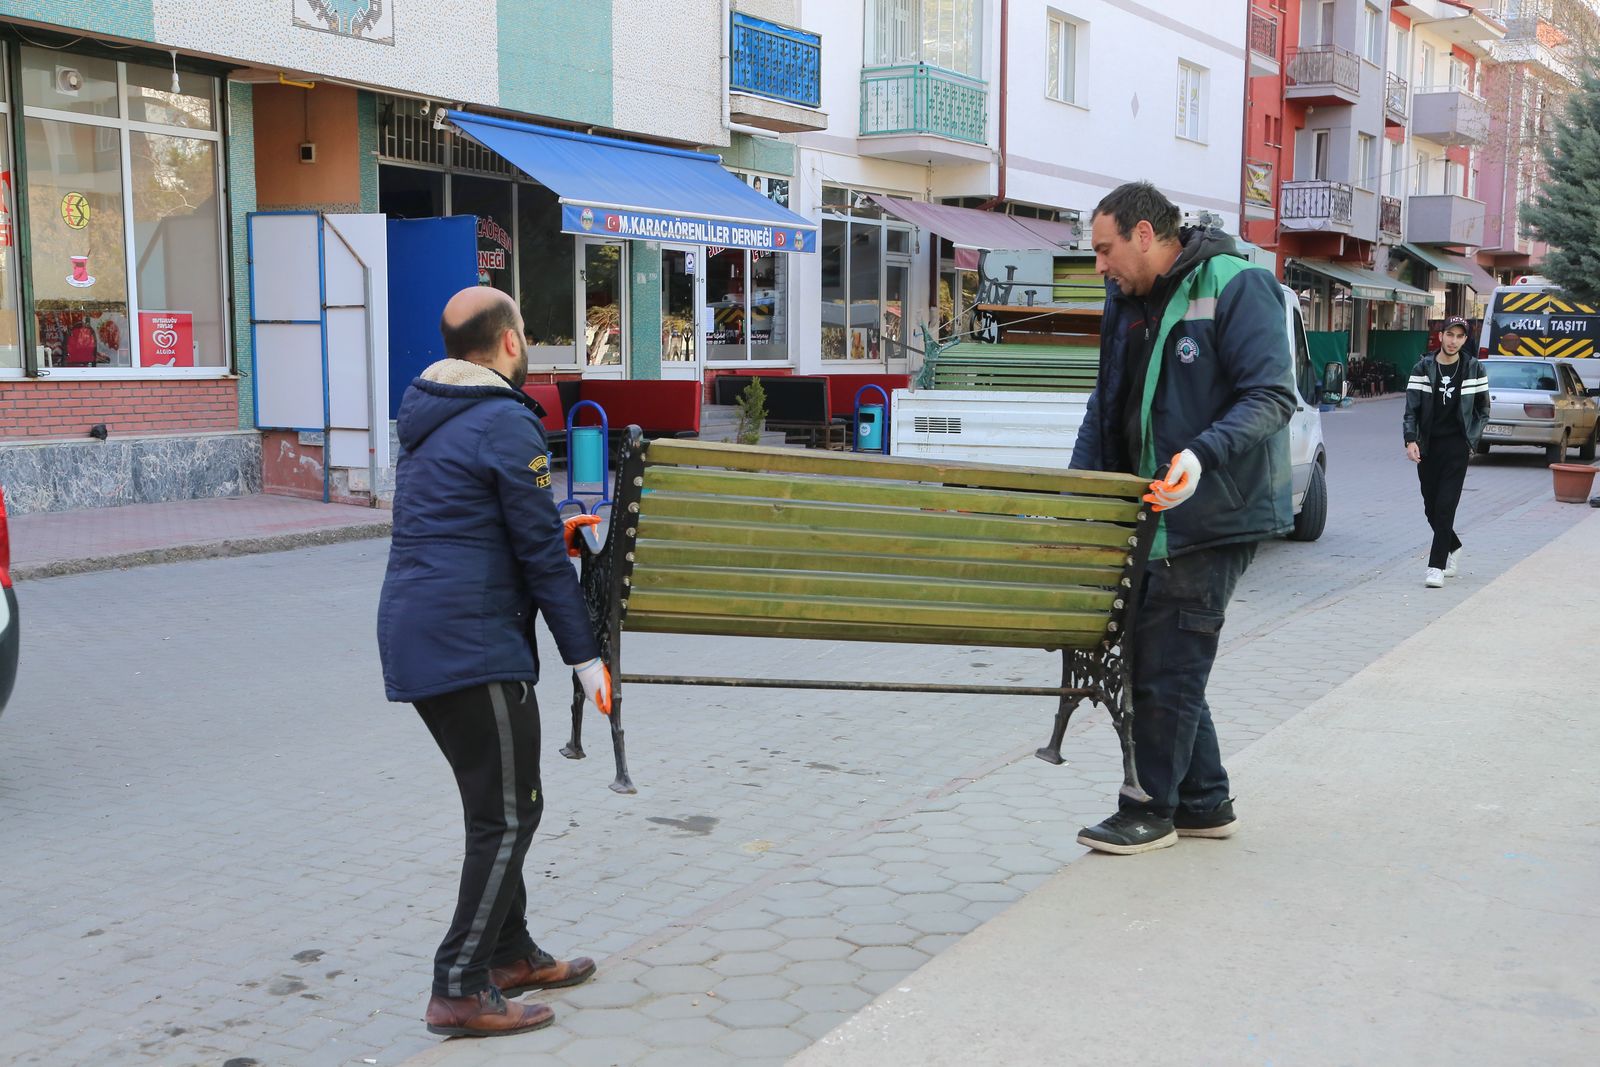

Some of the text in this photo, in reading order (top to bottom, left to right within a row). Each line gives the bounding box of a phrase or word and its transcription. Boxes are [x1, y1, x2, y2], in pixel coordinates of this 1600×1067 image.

[732, 227, 772, 248] DERNEĞİ
[1510, 319, 1587, 334] OKUL TAŞITI
